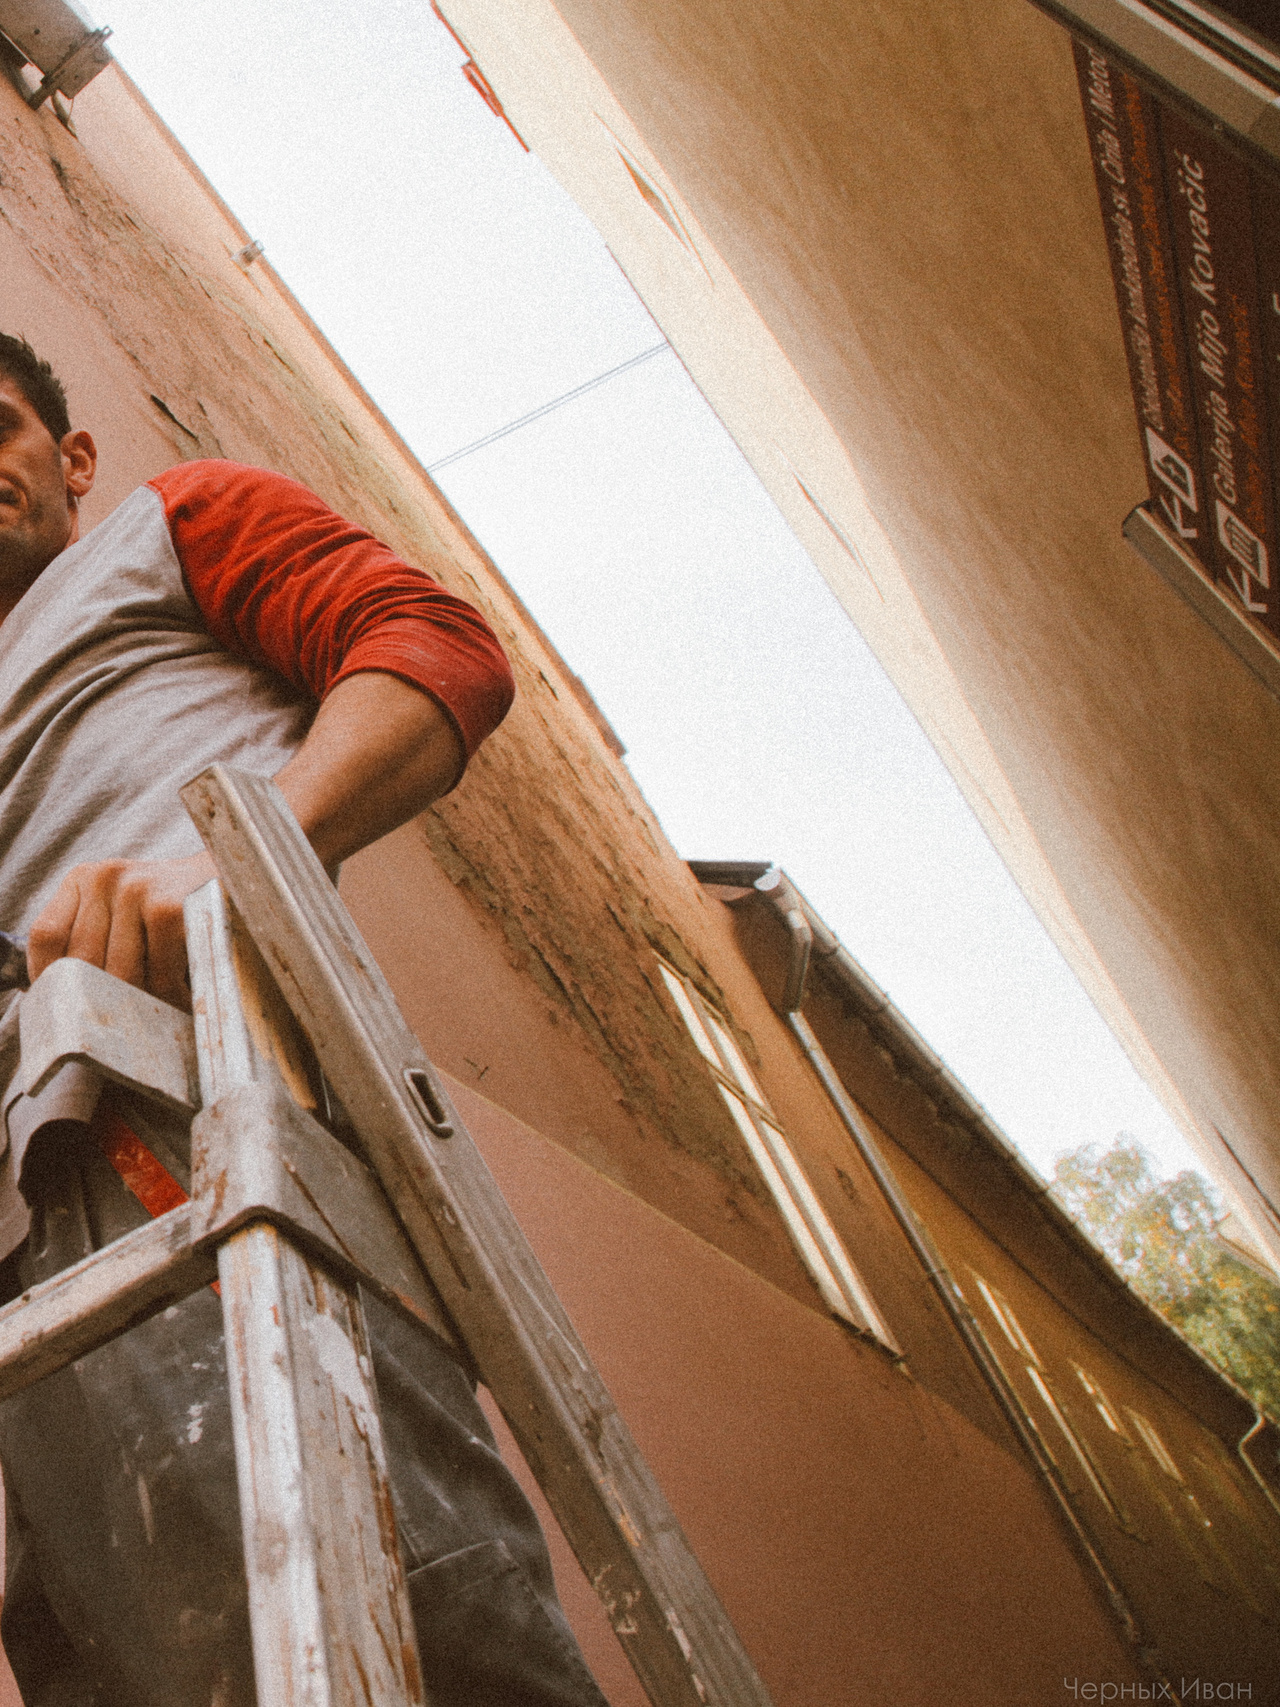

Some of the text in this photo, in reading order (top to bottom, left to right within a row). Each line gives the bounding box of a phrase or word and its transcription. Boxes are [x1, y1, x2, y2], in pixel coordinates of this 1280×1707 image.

[1080, 40, 1116, 120] Metod
[1174, 149, 1237, 505] Galerija Mijo Kovačić
